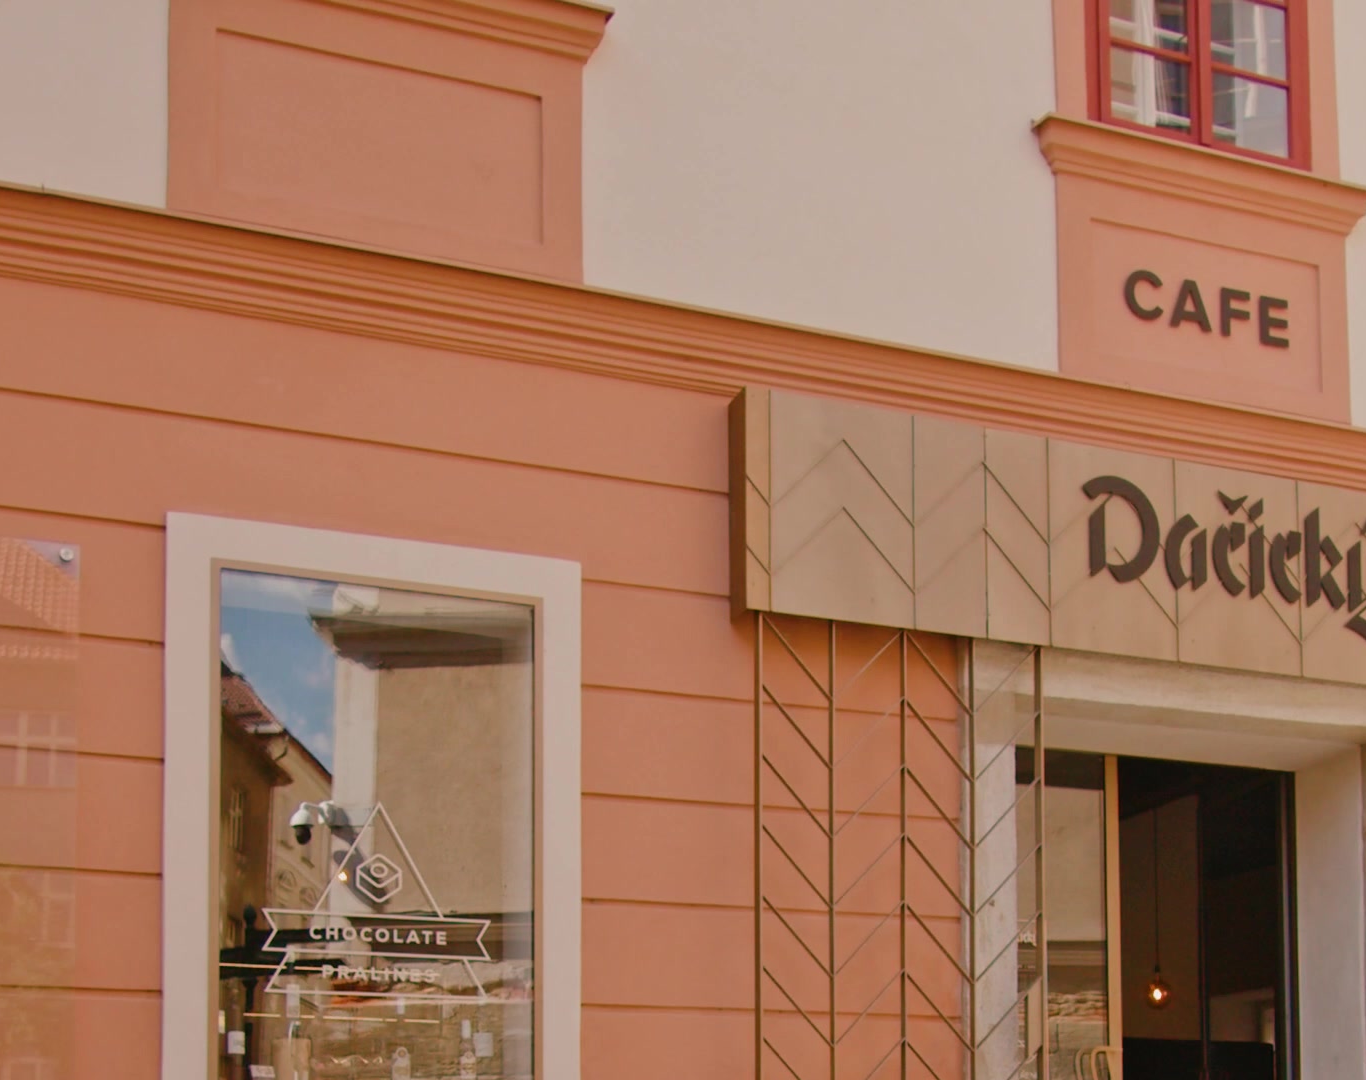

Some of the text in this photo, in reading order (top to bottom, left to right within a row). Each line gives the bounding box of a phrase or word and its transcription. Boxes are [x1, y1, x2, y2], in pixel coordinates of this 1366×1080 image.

[1124, 269, 1289, 349] CAFE
[308, 925, 448, 946] CHOCOLATE
[321, 964, 436, 983] PRALINES
